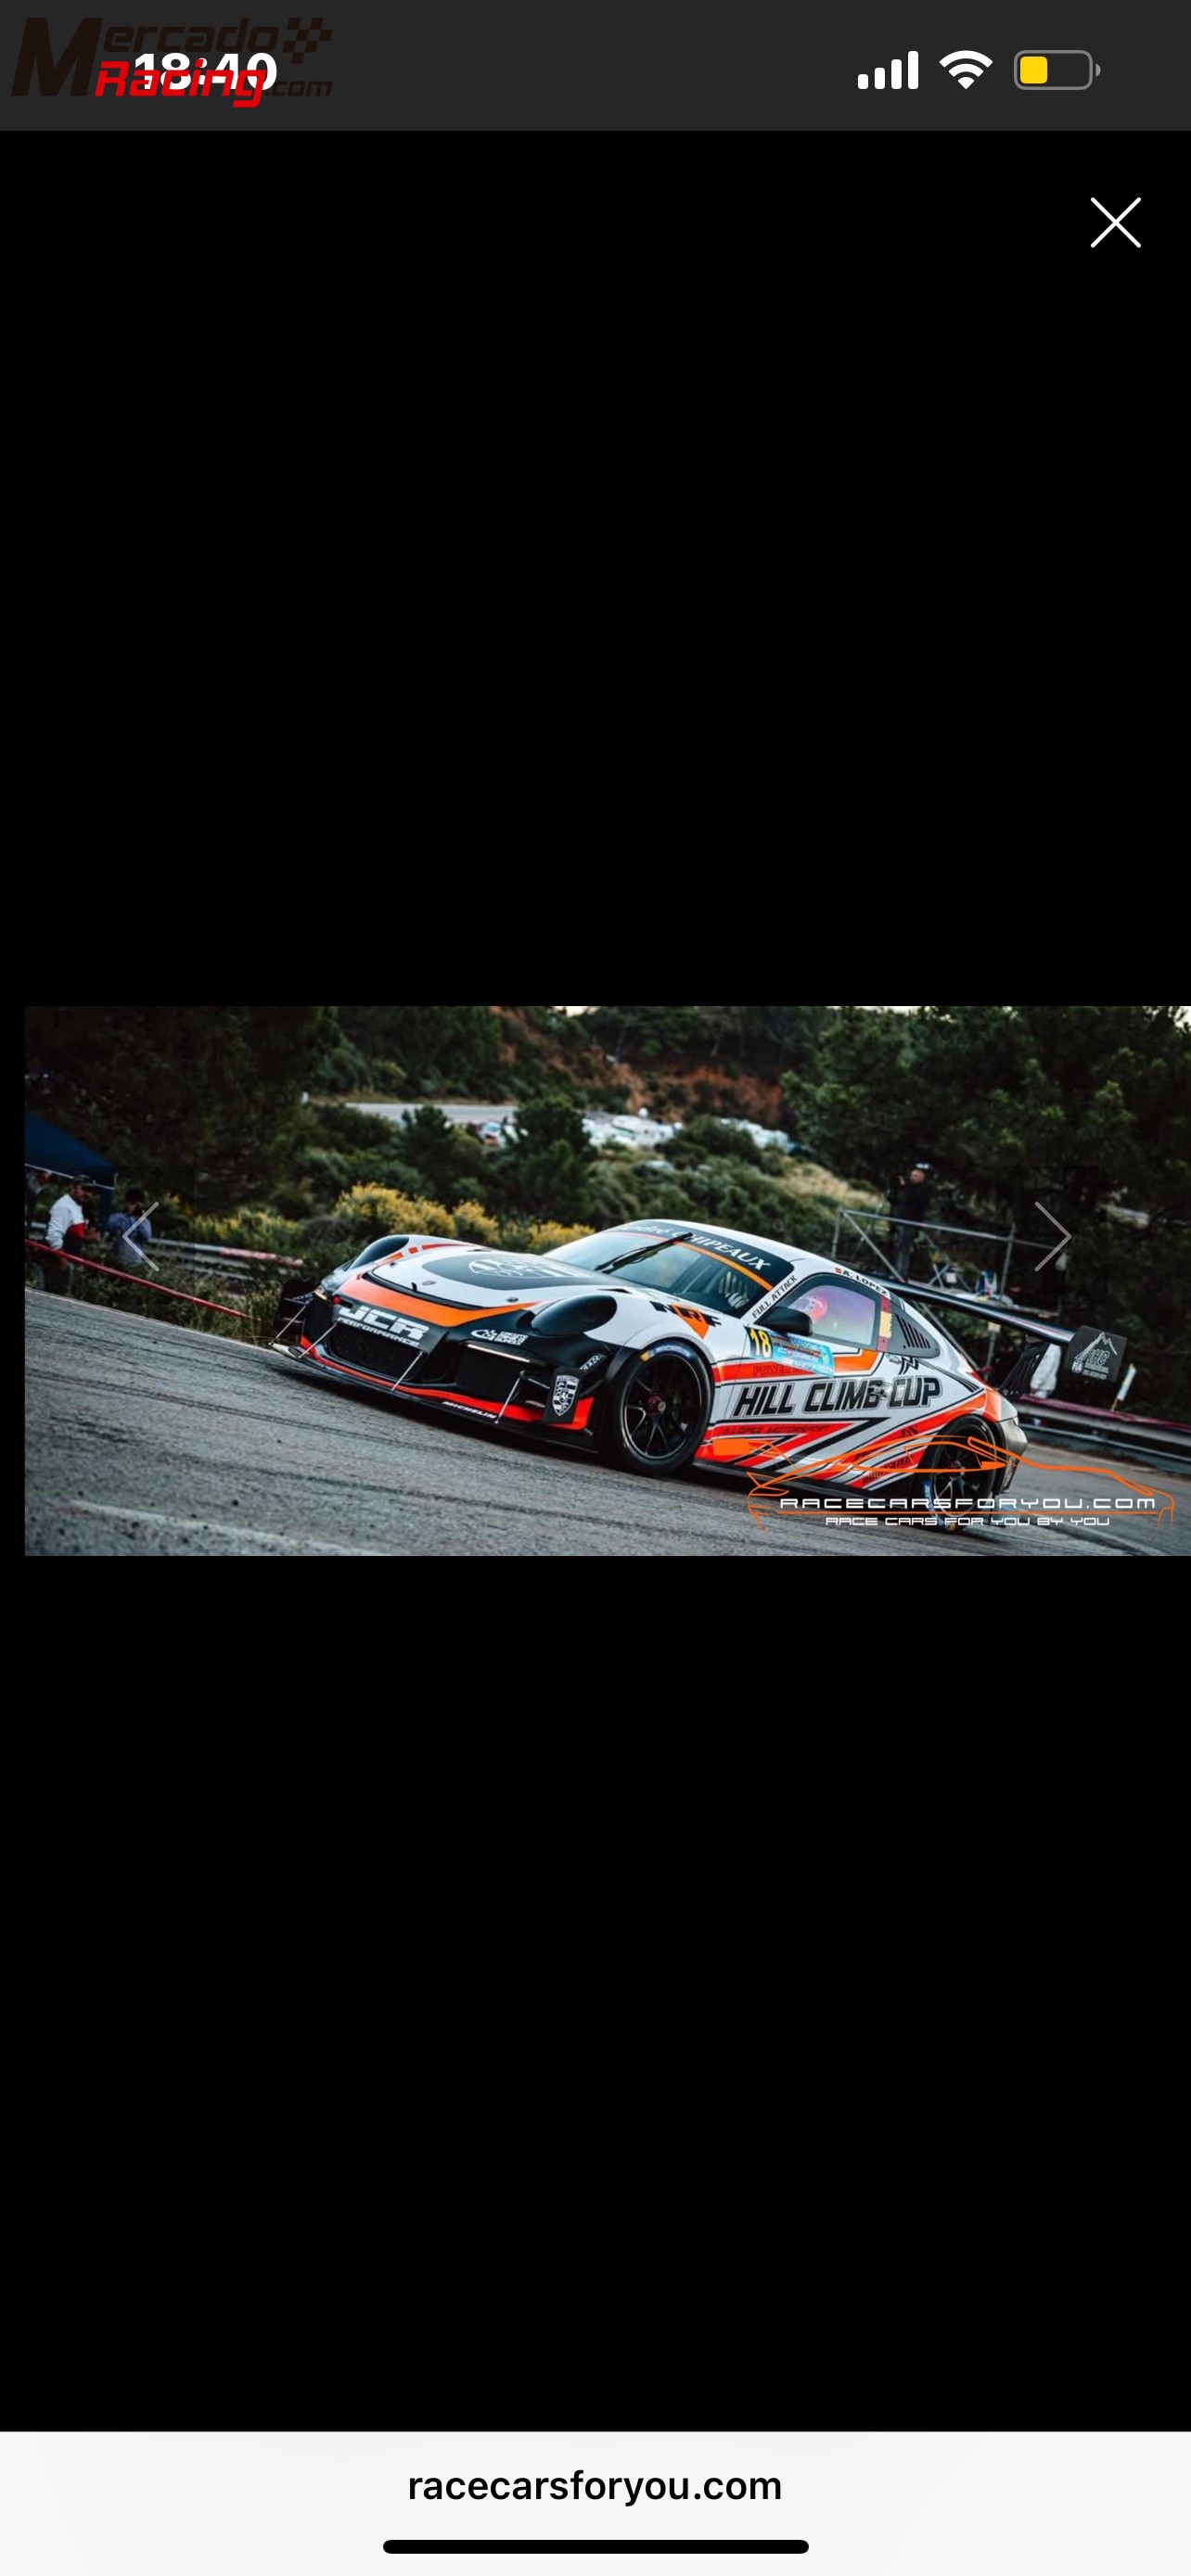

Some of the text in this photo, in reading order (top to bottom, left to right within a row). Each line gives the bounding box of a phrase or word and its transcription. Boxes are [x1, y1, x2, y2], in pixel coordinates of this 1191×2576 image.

[134, 53, 277, 90] 18:40
[751, 1273, 799, 1320] FULL ATTACK
[336, 1316, 421, 1346] PERFORMANCE
[338, 1305, 430, 1341] JCR
[749, 1327, 772, 1358] 18
[442, 1400, 498, 1420] MICHELIN
[730, 1375, 943, 1419] HILL CLIMB CUP
[408, 2469, 782, 2507] racecarsforyou.com
